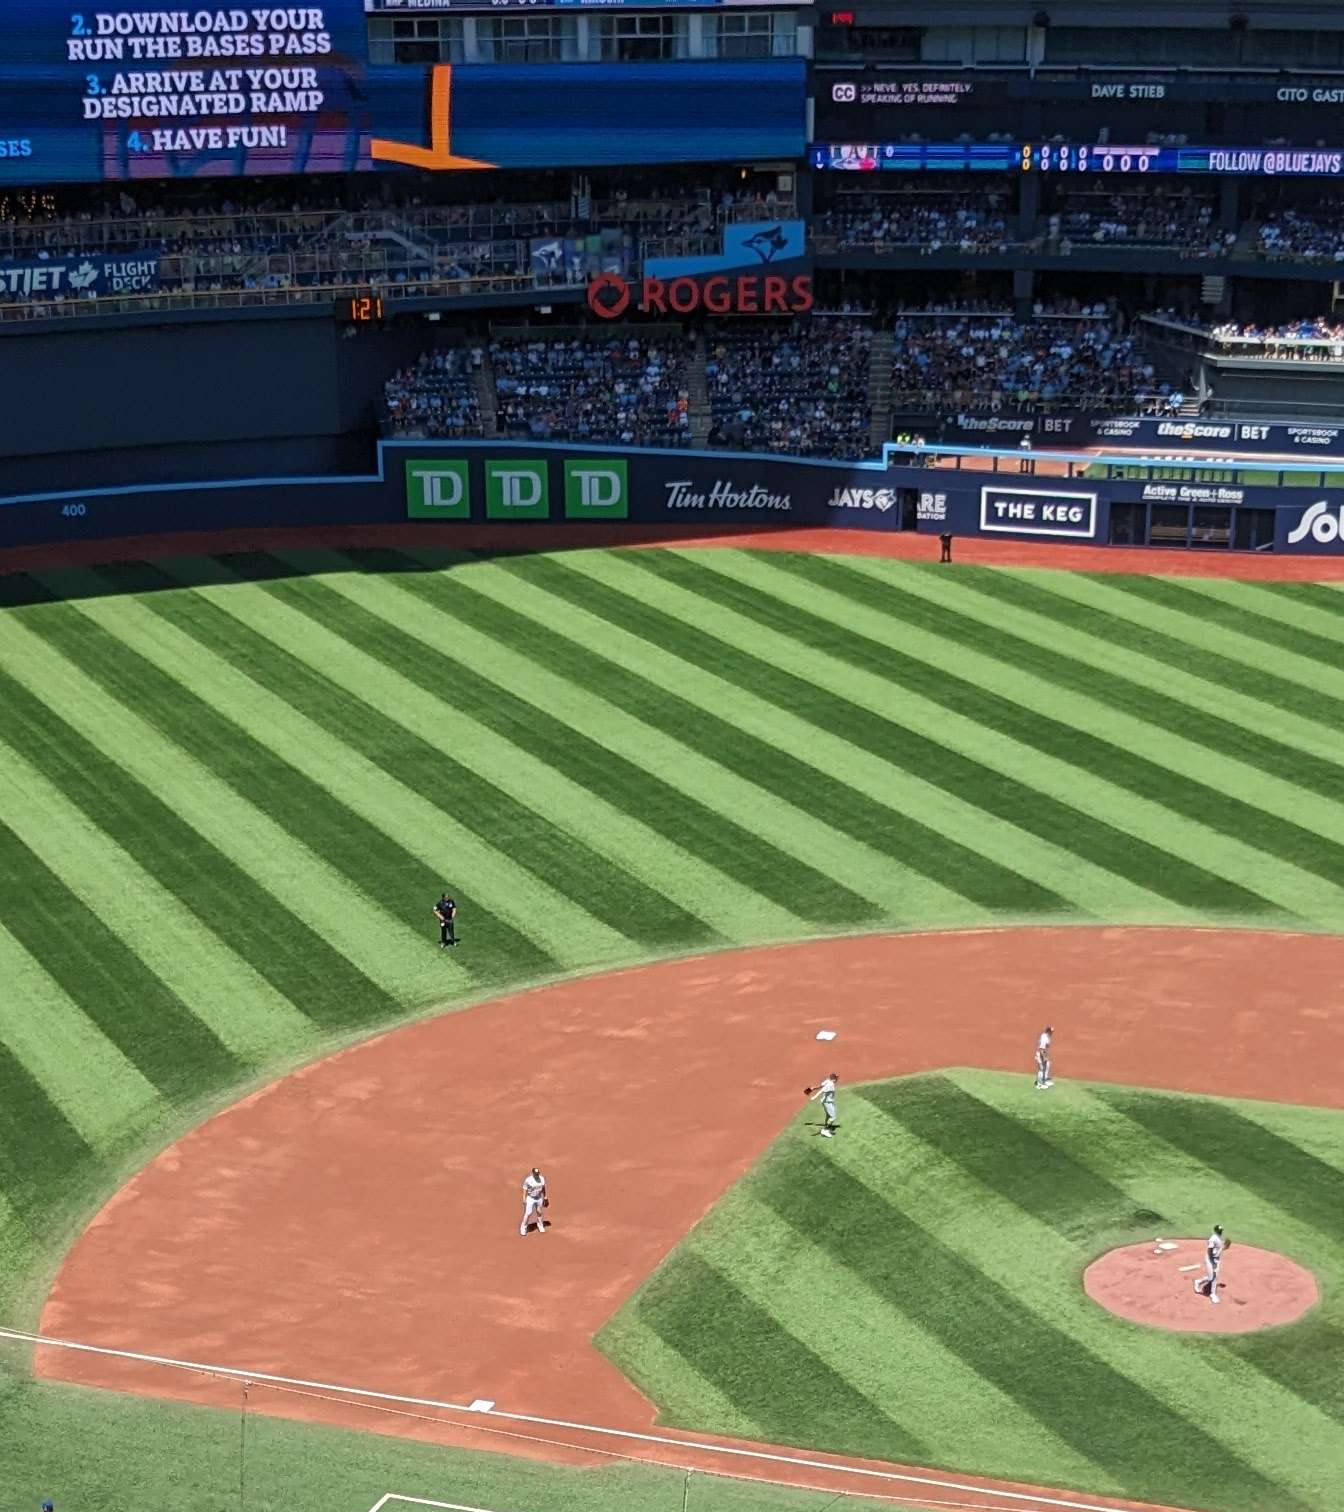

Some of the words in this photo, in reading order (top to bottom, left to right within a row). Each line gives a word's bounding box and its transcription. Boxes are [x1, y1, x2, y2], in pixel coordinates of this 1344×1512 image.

[72, 15, 93, 36] 2.
[97, 12, 249, 36] DOWNLOAD
[253, 9, 325, 31] YOUR
[67, 38, 125, 61] RUN
[128, 36, 183, 58] THE
[186, 34, 266, 57] BASES
[268, 33, 331, 55] PASS
[86, 74, 106, 95] 3.
[112, 70, 204, 94] ARRIVE
[209, 70, 243, 92] AT
[246, 68, 317, 89] YOUR
[834, 86, 854, 99] CC
[1092, 84, 1124, 99] DAVE
[1129, 84, 1166, 100] STIEB
[83, 94, 246, 119] DESIGNATED
[250, 91, 325, 113] RAMP
[1277, 88, 1309, 102] CITO
[127, 131, 150, 151] 4.
[152, 128, 224, 152] HAVE
[226, 126, 287, 148] FUN!
[1209, 152, 1261, 170] FOLLOW
[1264, 152, 1340, 175] @BLUEJAYS
[104, 260, 158, 279] FLIGHT
[112, 275, 150, 291] DECK
[644, 276, 814, 314] ROGERS
[1045, 418, 1073, 434] BET
[1157, 422, 1231, 440] theScore
[1242, 426, 1270, 441] BET
[1288, 426, 1339, 438] SPORTSBOOK
[411, 470, 464, 507] TD
[491, 470, 543, 507] TD
[570, 470, 622, 507] TD
[665, 481, 709, 510] Tim
[708, 481, 792, 512] Hortons
[827, 488, 875, 510] JAYS
[1143, 485, 1177, 499] Active
[62, 503, 86, 518] 400
[994, 501, 1036, 520] THE
[1042, 504, 1084, 523] KEG
